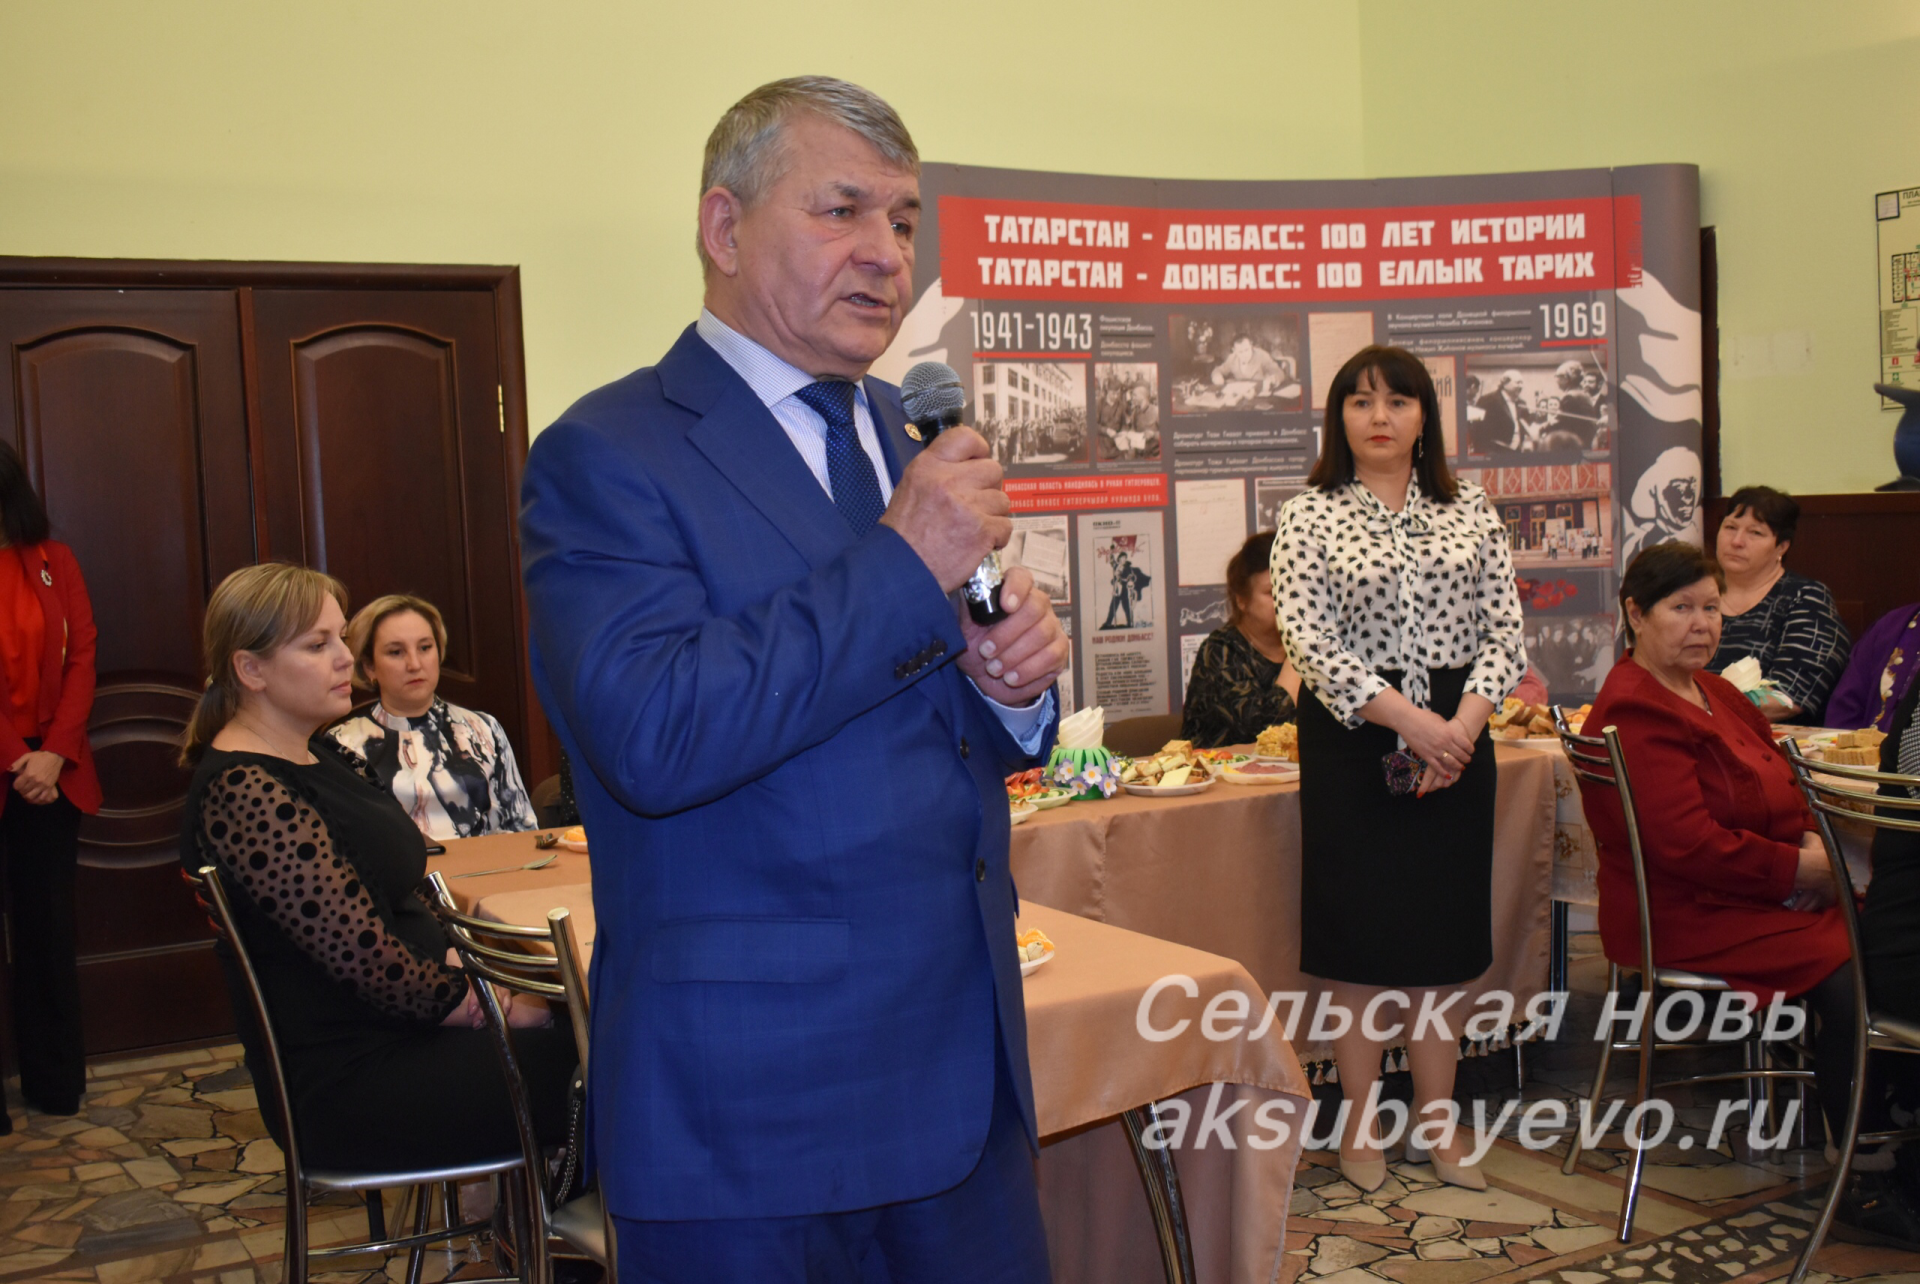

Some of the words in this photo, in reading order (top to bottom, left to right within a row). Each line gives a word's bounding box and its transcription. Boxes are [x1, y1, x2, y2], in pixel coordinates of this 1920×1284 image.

[1902, 189, 1920, 200] ПЛА
[984, 214, 1129, 248] ТАТАРСТАН
[1165, 224, 1304, 251] ДОНБАСС:
[1321, 223, 1366, 249] 100
[1381, 220, 1435, 248] ЛЕТ
[1451, 213, 1585, 245] ИСТОРИИ
[978, 257, 1123, 289] ТАТАРСТАН
[1162, 263, 1301, 290] ДОНБАСС:
[1317, 262, 1362, 289] 100
[1379, 257, 1484, 287] ЕЛЛЫК
[1498, 252, 1595, 282] ТАРИХ
[970, 311, 1092, 350] 1941-1943
[1539, 301, 1607, 338] 1969
